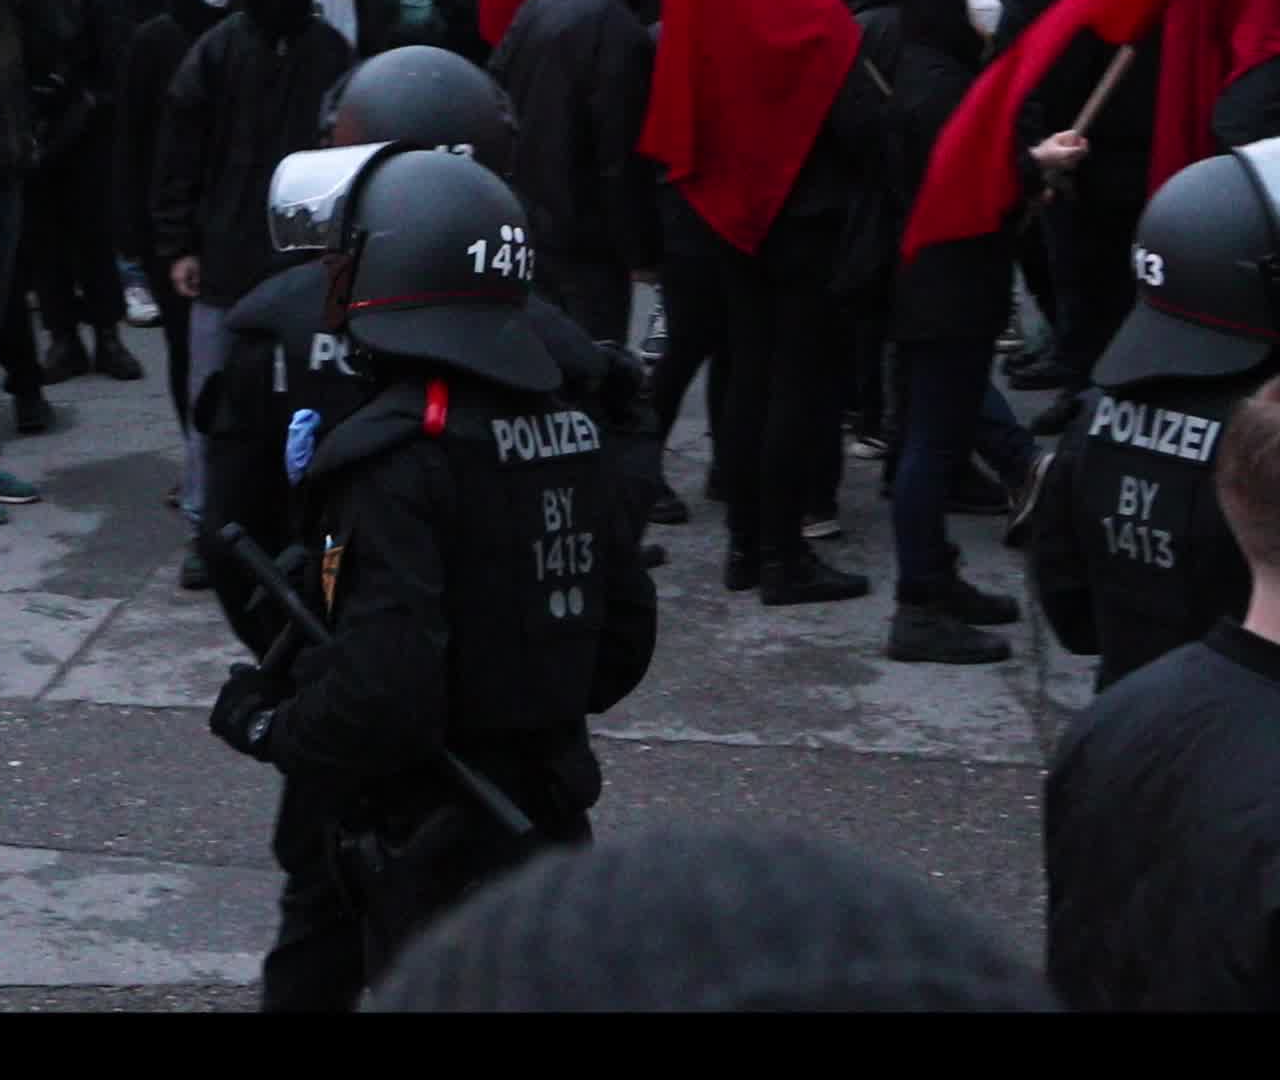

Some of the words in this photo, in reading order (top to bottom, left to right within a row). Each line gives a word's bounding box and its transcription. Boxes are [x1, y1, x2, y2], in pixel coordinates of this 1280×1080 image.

[492, 410, 601, 463] POLIZEI
[1088, 396, 1220, 463] POLIZEI
[542, 487, 575, 531] BY
[1119, 474, 1160, 517] BY
[531, 531, 594, 582] 1413
[1101, 517, 1174, 569] 1413
